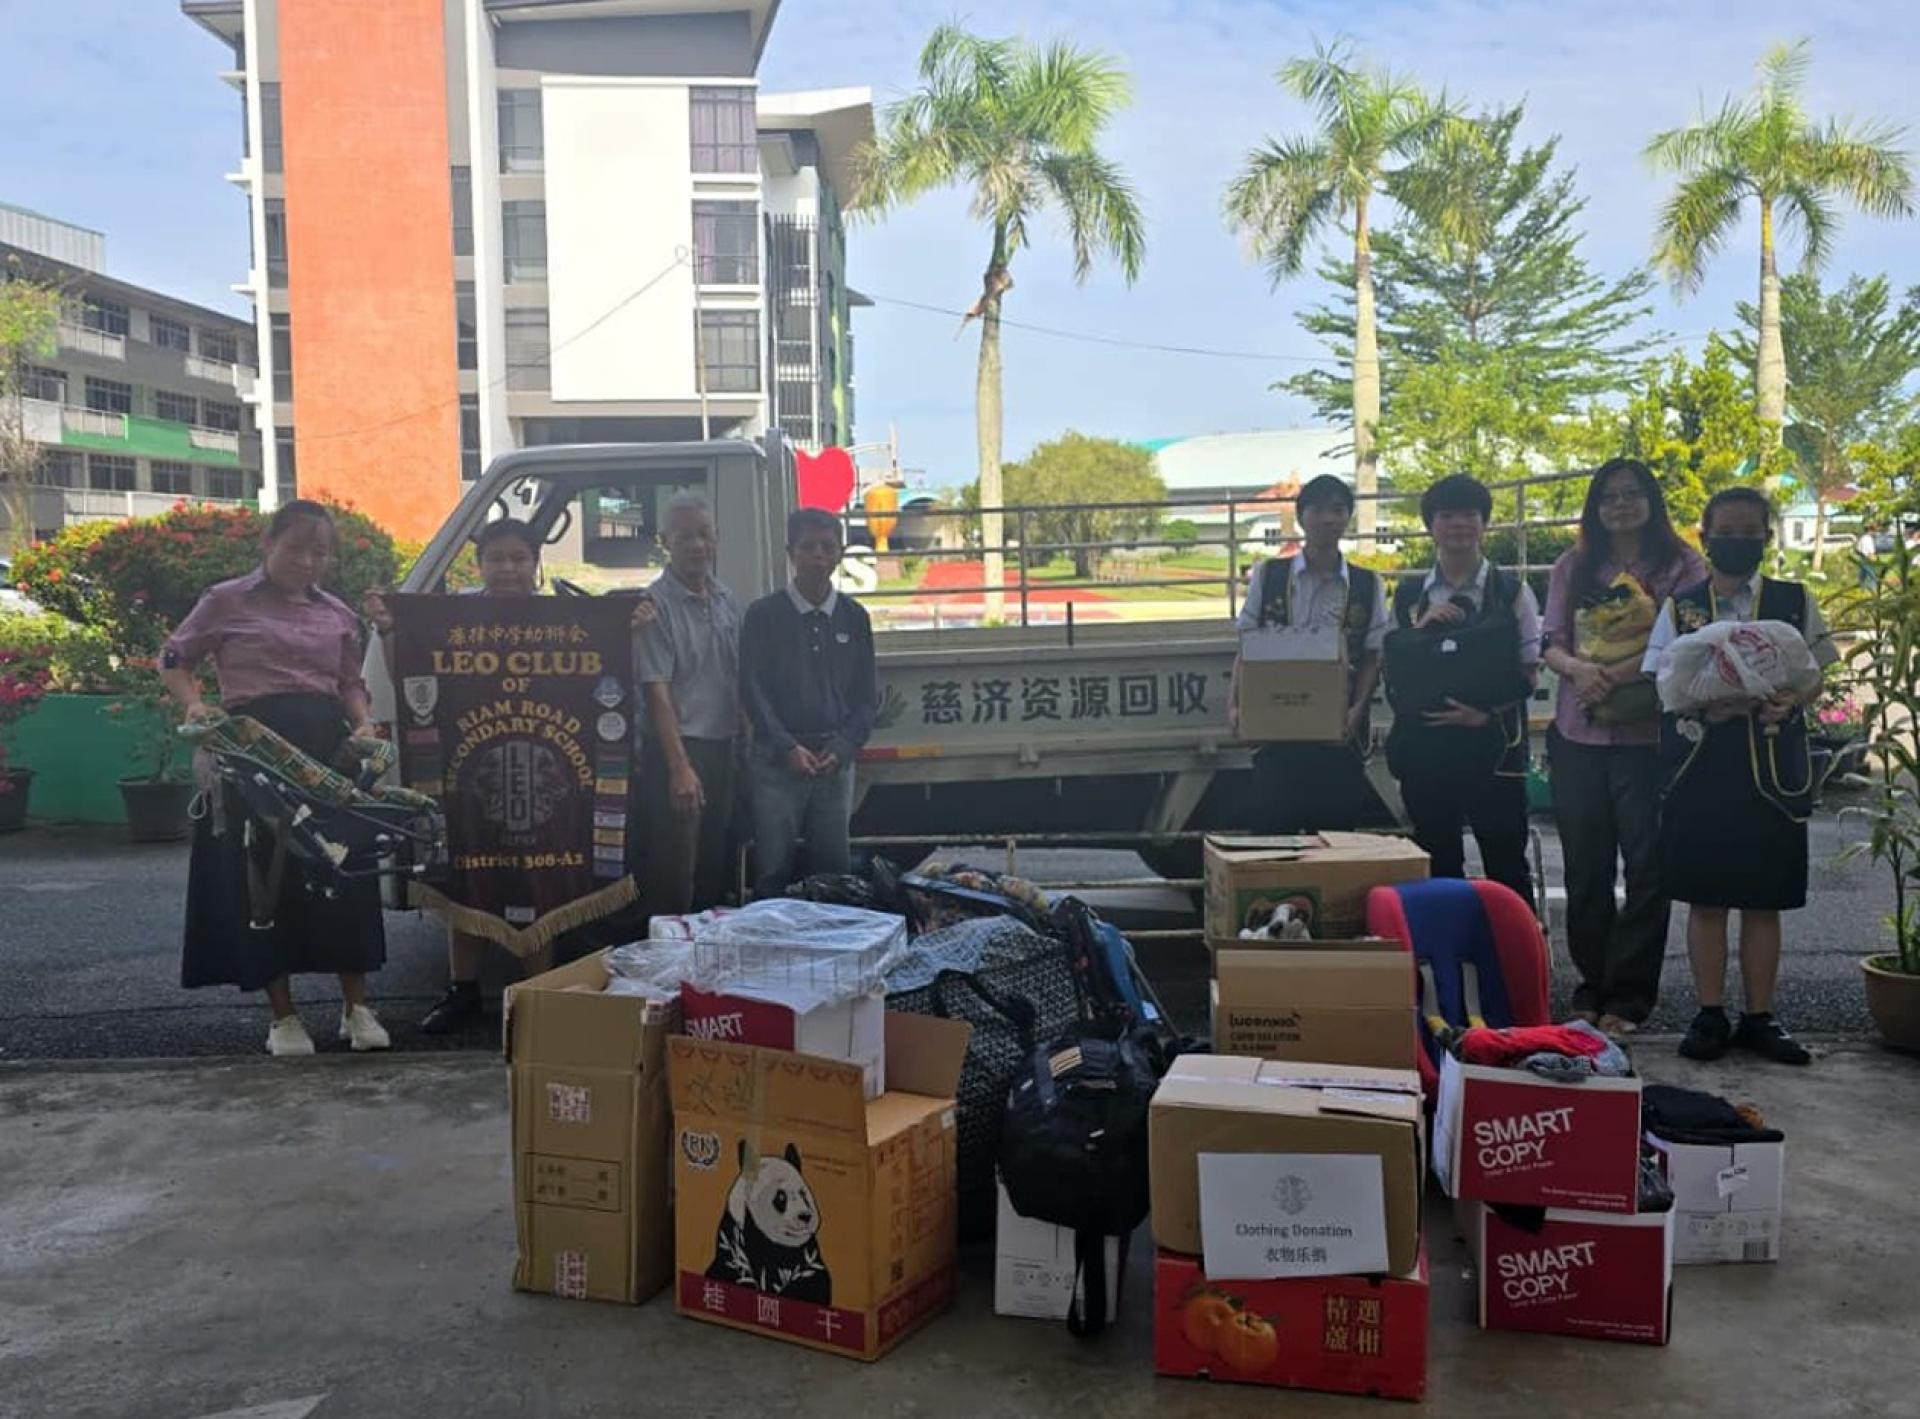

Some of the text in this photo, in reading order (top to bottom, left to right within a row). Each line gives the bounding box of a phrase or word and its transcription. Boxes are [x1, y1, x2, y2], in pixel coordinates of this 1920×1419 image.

[432, 651, 602, 675] LEO CLUB
[502, 677, 532, 693] OF
[921, 671, 1232, 726] 慈济资源回收
[457, 699, 512, 731] RIAM
[521, 700, 582, 732] ROAD
[454, 853, 519, 870] District
[684, 1012, 744, 1041] SMART
[1474, 1107, 1575, 1147] SMART
[1478, 1139, 1546, 1169] COPY
[1235, 1222, 1353, 1239] Clothing Donation
[1497, 1241, 1597, 1278] SMART
[1503, 1273, 1570, 1301] COPY
